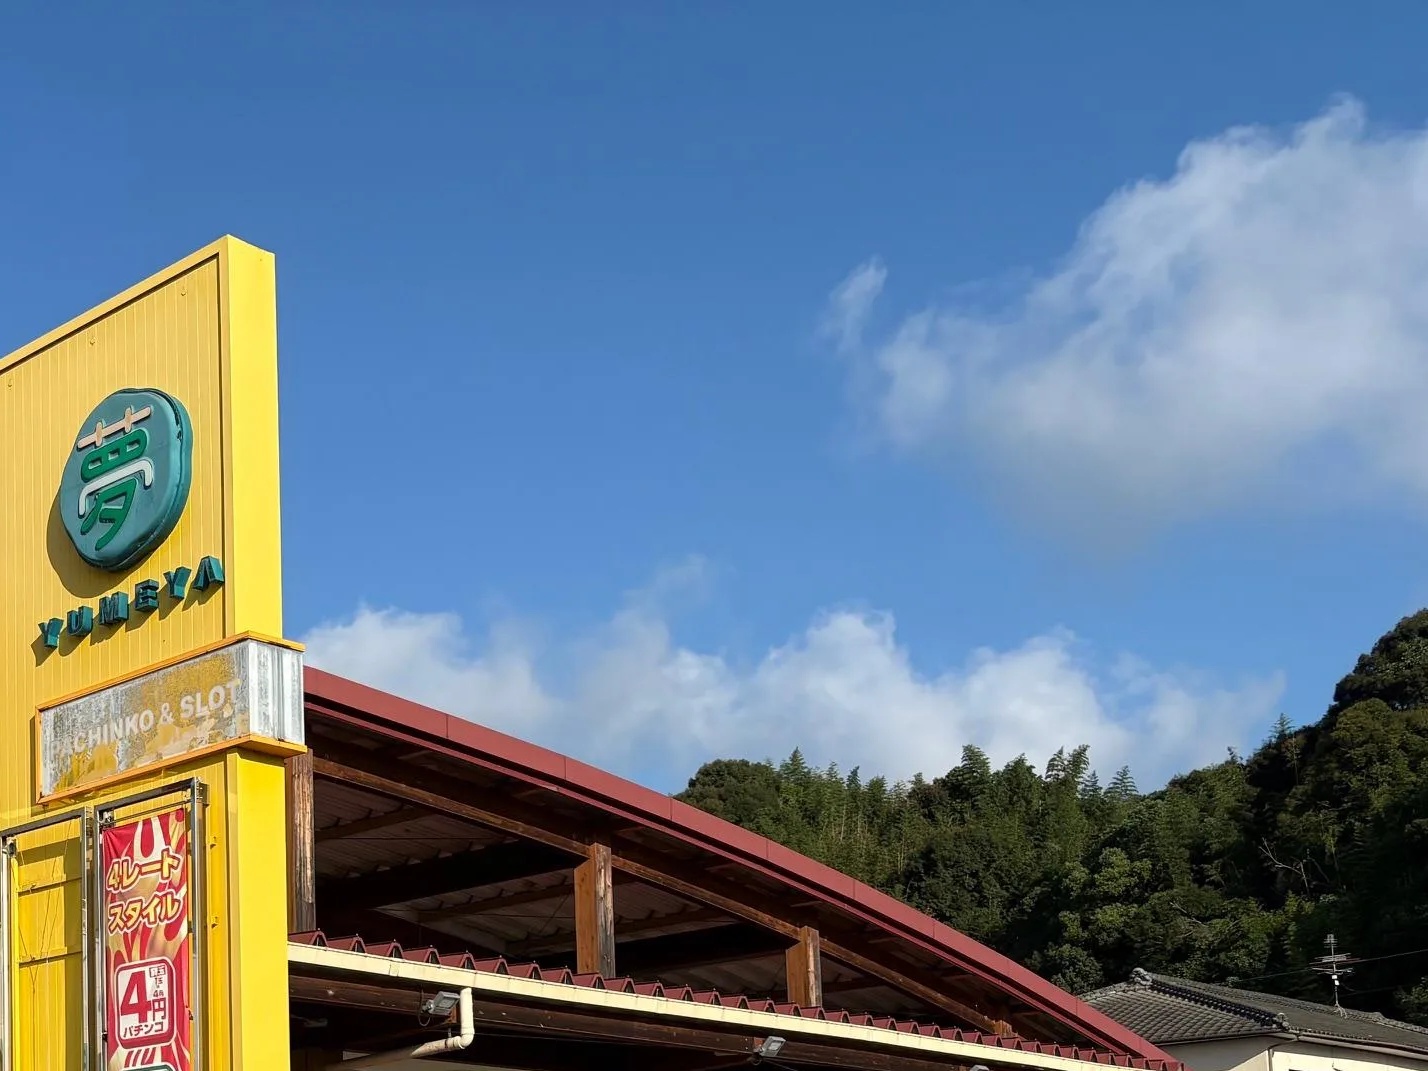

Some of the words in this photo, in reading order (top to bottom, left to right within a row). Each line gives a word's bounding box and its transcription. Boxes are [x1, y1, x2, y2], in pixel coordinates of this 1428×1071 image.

[77, 405, 153, 551] 夢
[38, 556, 225, 649] YUMEYA
[159, 702, 174, 725] &
[180, 679, 240, 719] SLOT
[108, 891, 181, 934] スタイル
[123, 1021, 164, 1038] パチンコ
